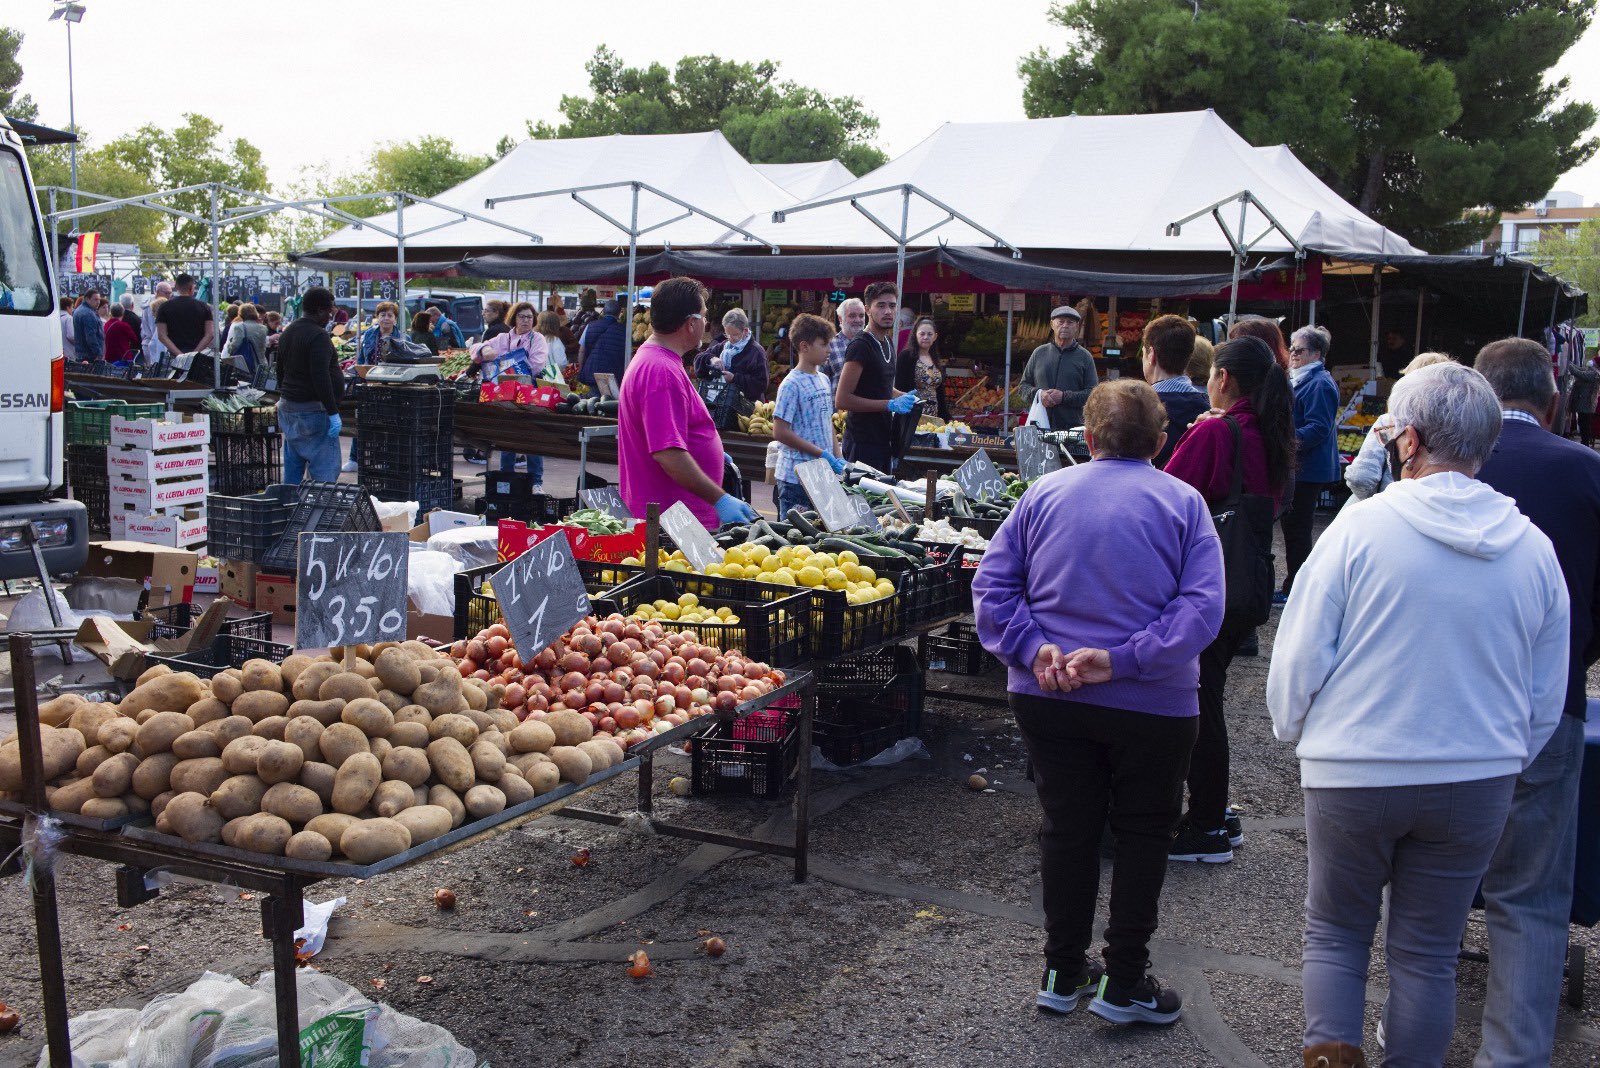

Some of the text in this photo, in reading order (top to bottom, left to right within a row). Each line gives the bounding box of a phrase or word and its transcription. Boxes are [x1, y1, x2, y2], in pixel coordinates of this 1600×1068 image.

[0, 393, 49, 408] SSAN
[971, 435, 1006, 446] Undella
[304, 533, 335, 601] 5
[505, 562, 521, 605] 1
[527, 594, 549, 651] 1
